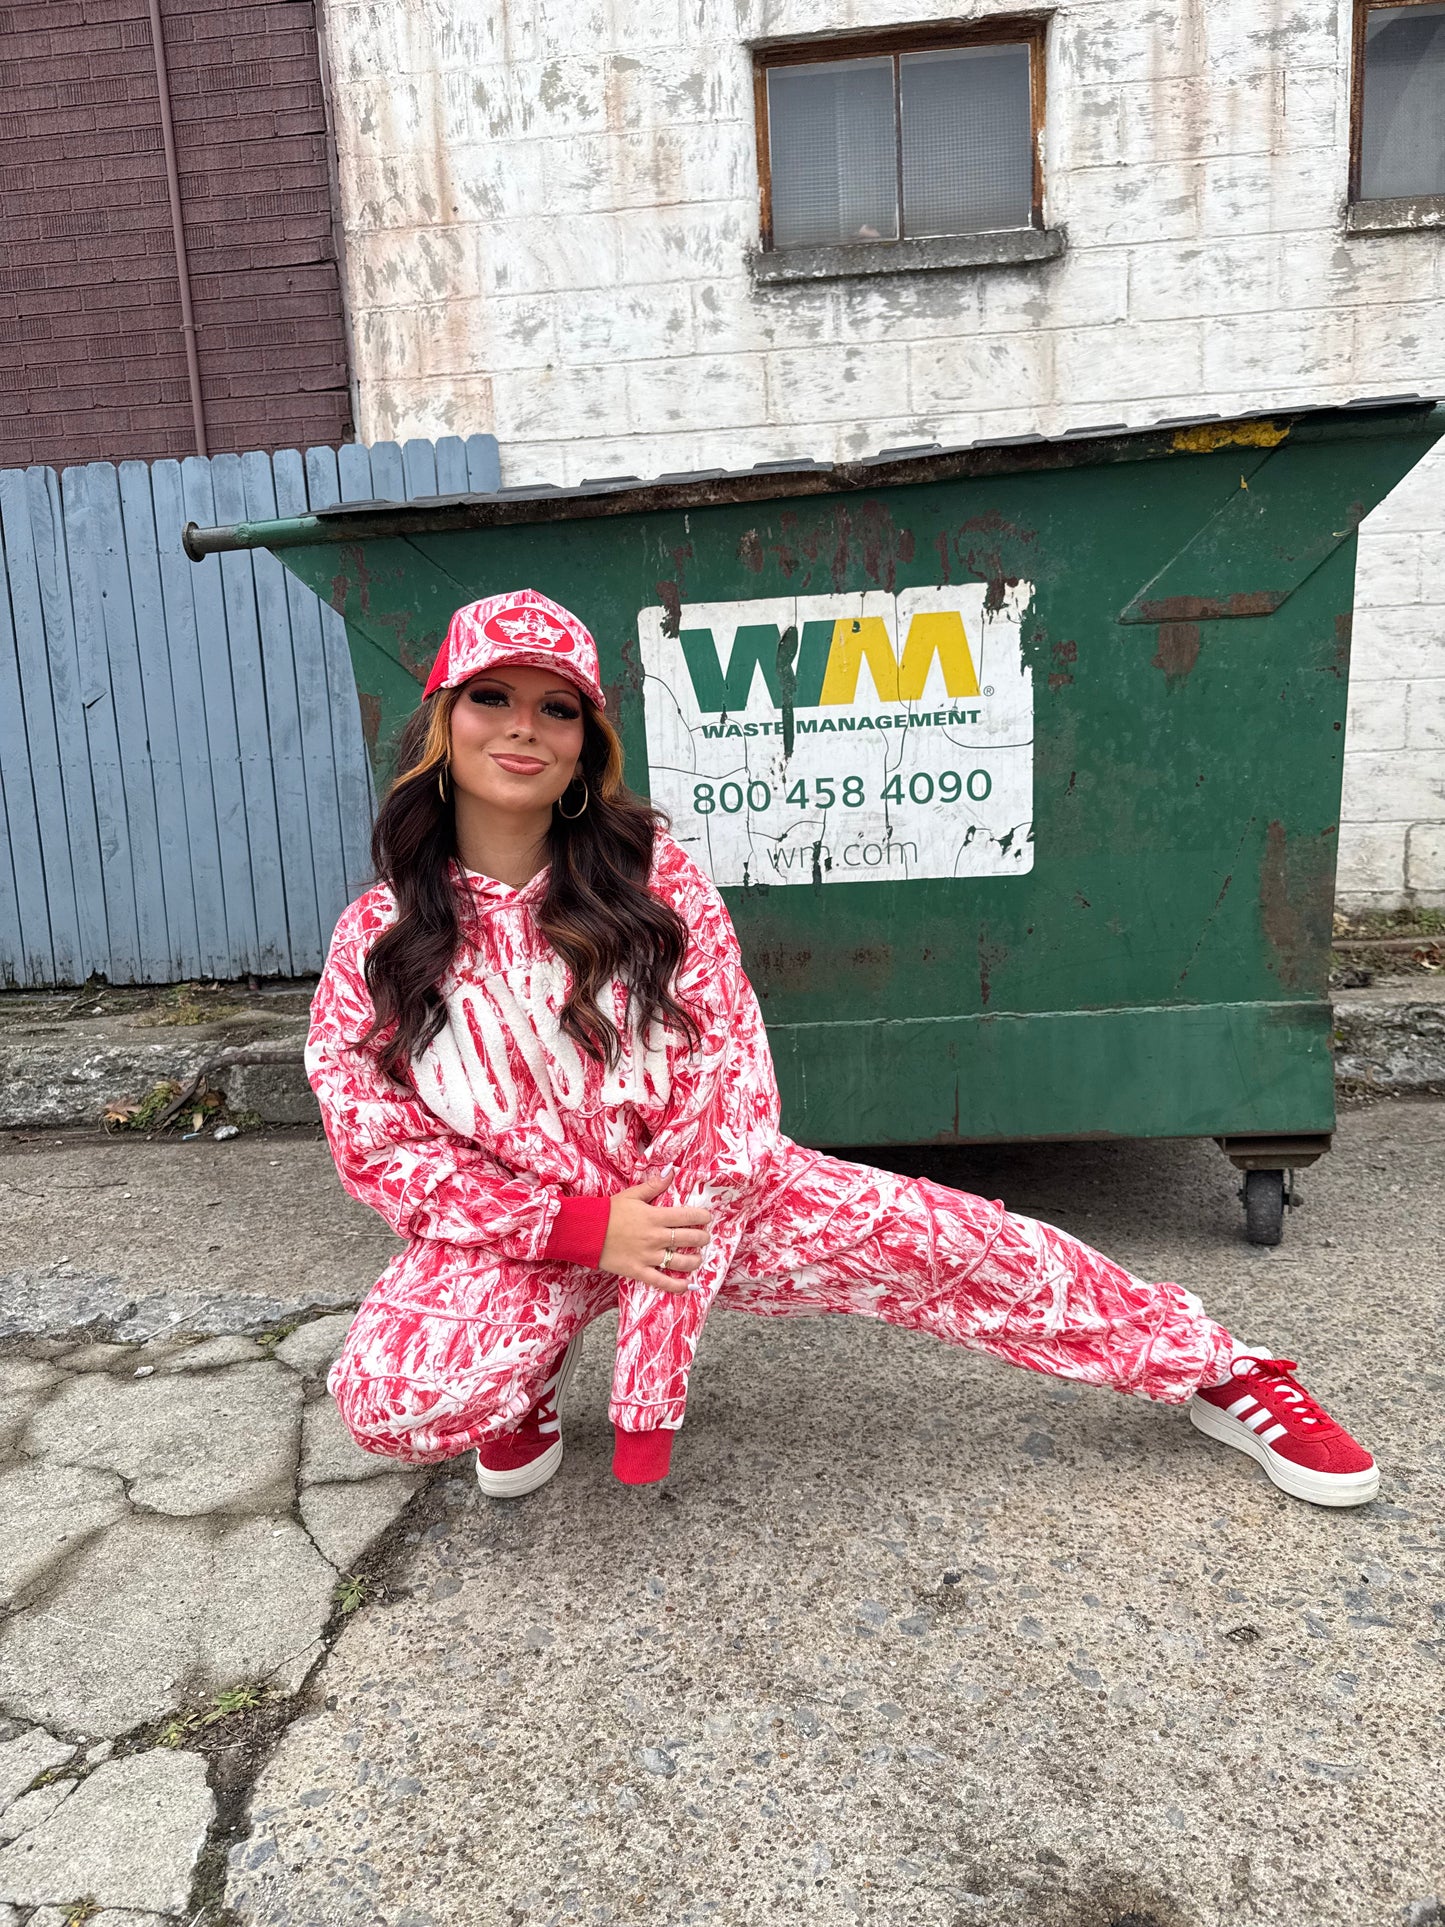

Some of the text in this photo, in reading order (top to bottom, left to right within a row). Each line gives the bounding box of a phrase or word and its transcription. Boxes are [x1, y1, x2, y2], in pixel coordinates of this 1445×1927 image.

[678, 610, 982, 714] WM
[701, 708, 982, 739] WASTE MANAGEMENT
[693, 768, 993, 815] 800 458 4090
[766, 841, 918, 870] wm.com
